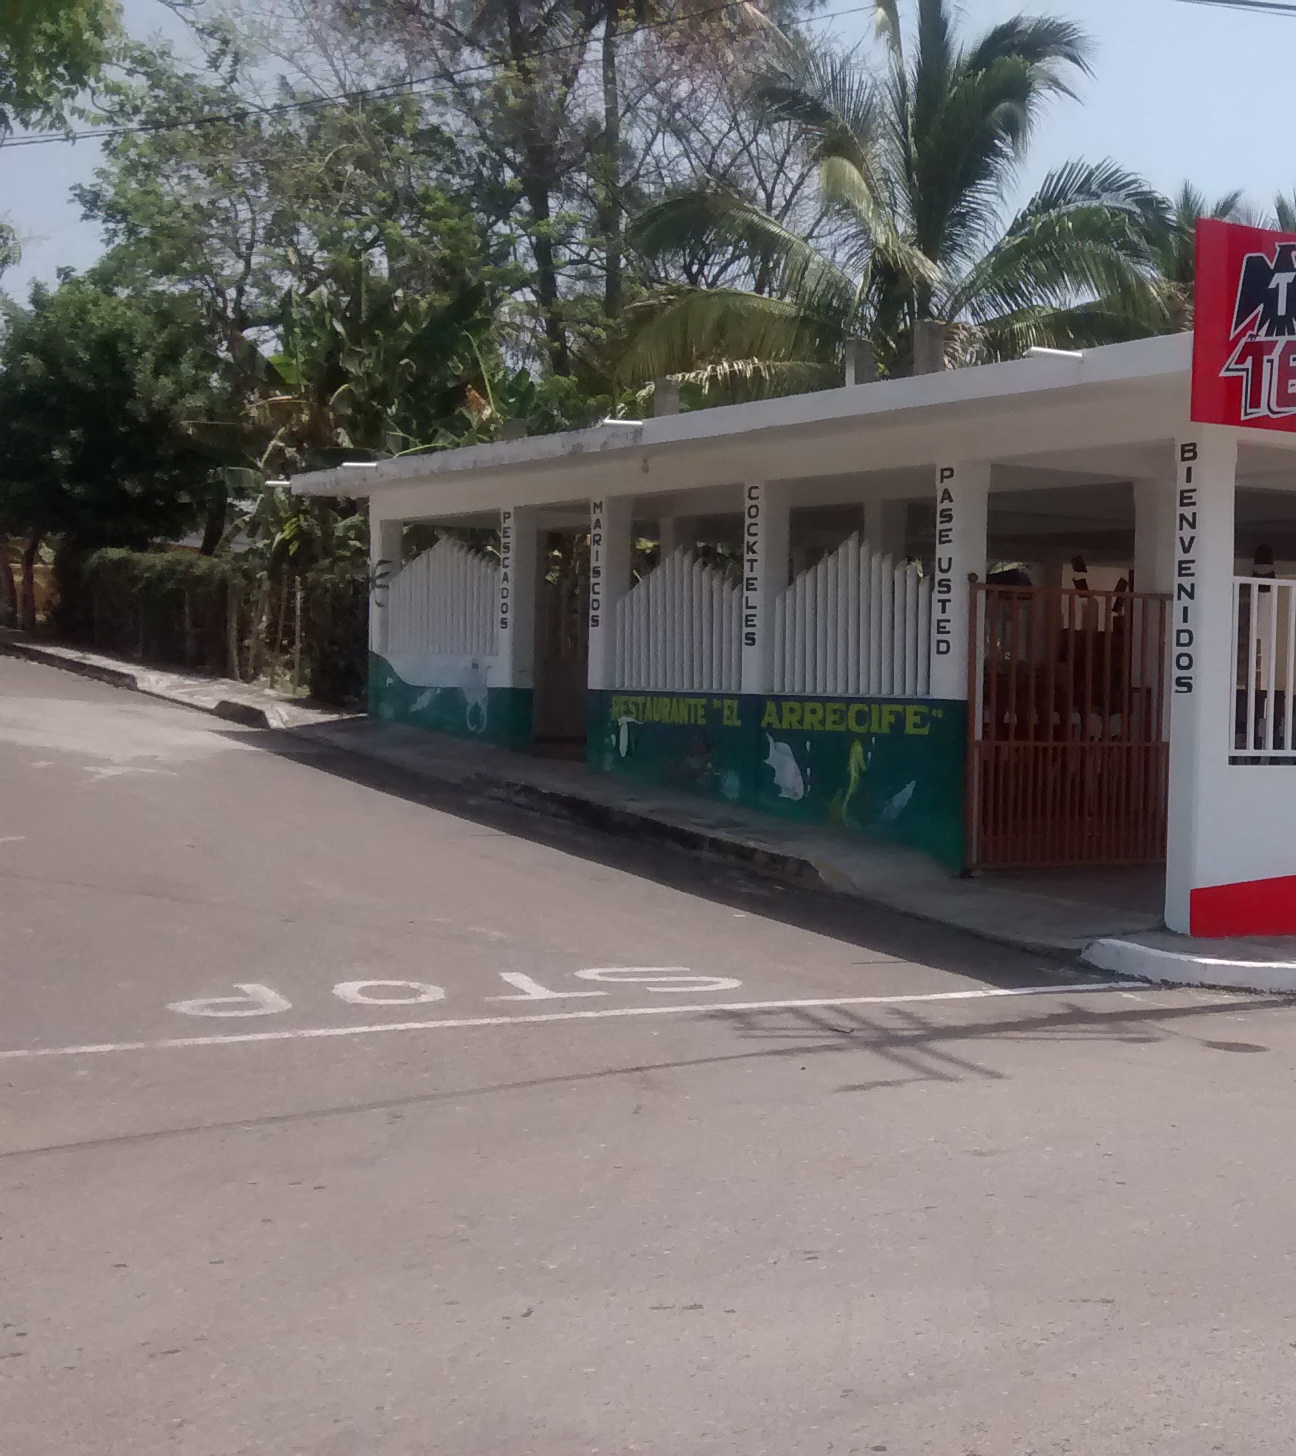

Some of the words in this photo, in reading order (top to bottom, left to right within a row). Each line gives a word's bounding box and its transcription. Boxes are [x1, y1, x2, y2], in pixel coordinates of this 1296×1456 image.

[589, 501, 603, 628] MARISCOS
[937, 466, 955, 545] PASE
[499, 510, 512, 630] PESCADOS
[743, 485, 761, 647] COCKTELES
[935, 556, 953, 656] USTED
[1174, 442, 1199, 695] BIENVENIDOS
[612, 695, 707, 726] RESTAURANTE
